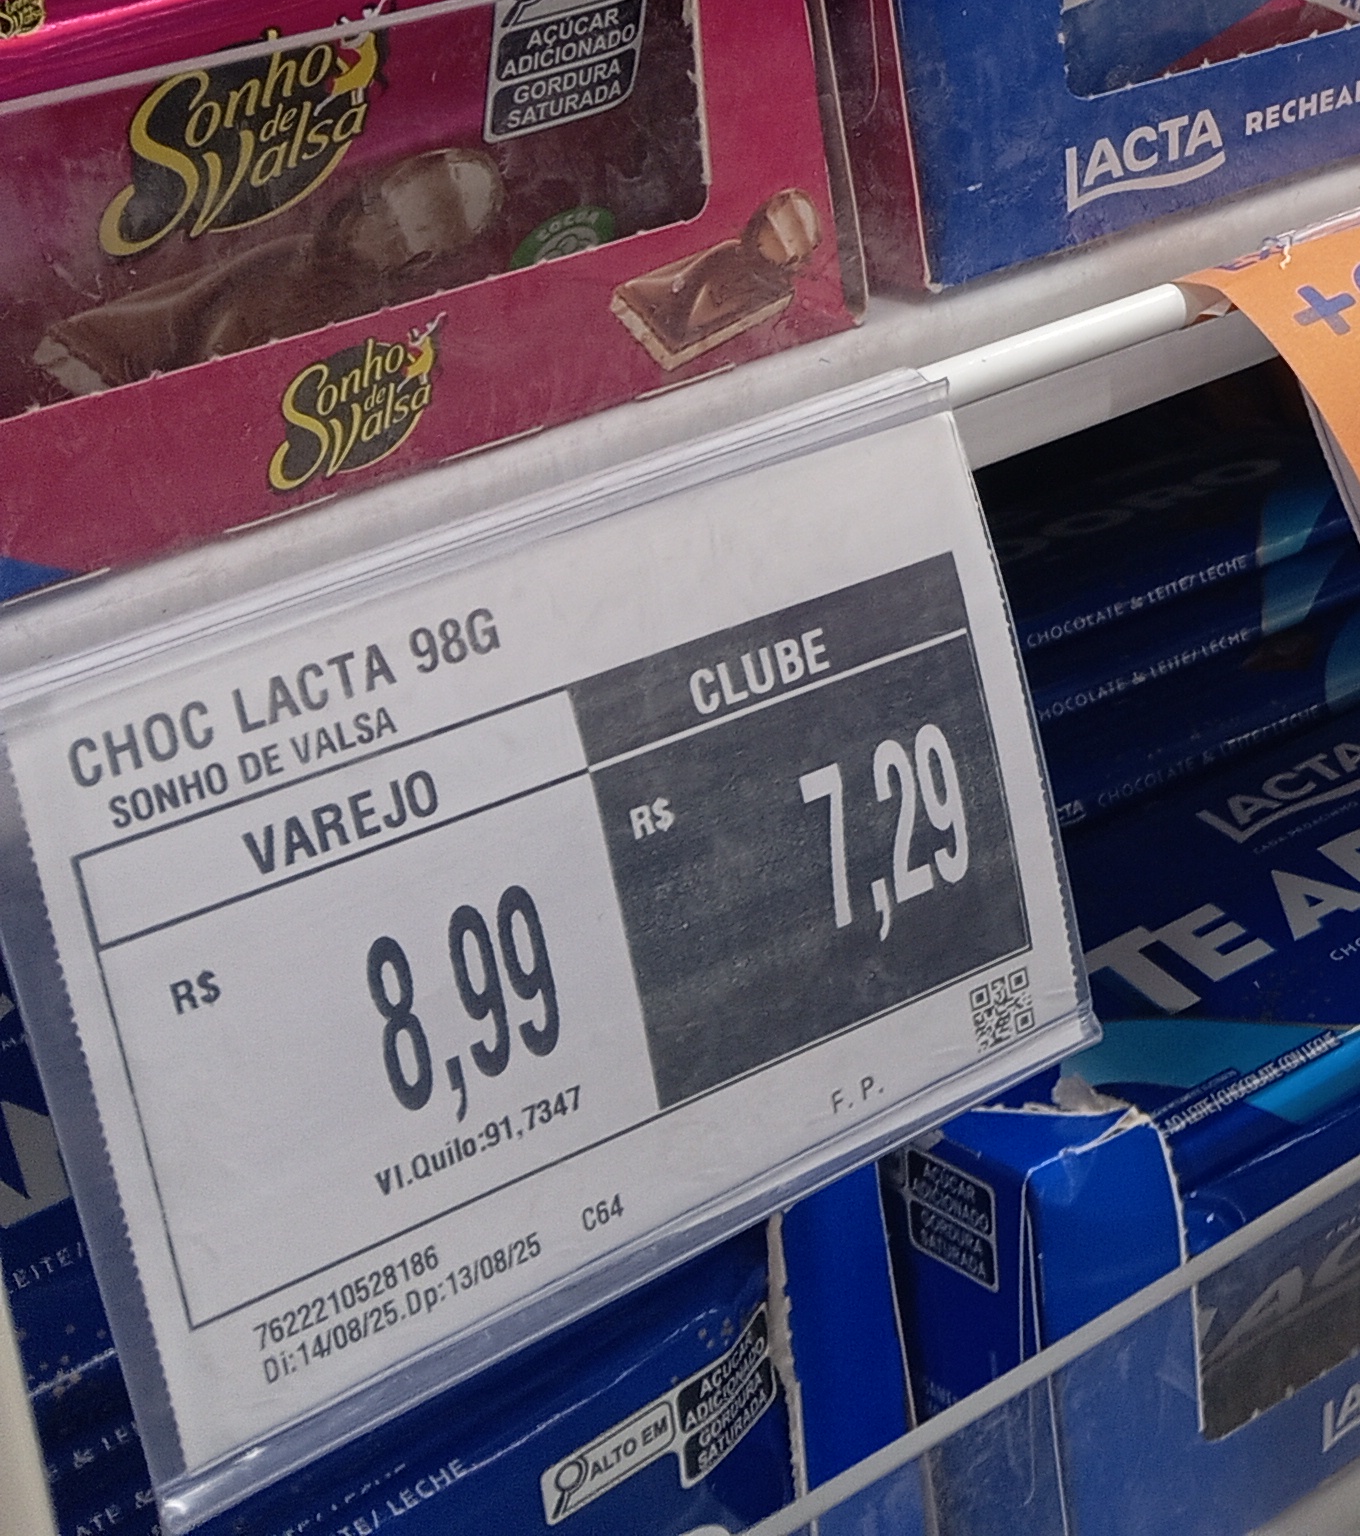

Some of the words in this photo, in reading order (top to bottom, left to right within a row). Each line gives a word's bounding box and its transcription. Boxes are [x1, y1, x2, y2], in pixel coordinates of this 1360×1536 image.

[501, 23, 635, 79] ADICIONADO
[526, 7, 619, 49] AÇÚCAR
[506, 80, 621, 129] SATURADA
[513, 59, 621, 104] GORDURA
[1065, 109, 1226, 214] LACTA
[1026, 601, 1125, 650] CHOCOLATE
[68, 696, 215, 789] CHOC
[231, 643, 398, 738] LACTA
[407, 605, 502, 677] 98G
[689, 628, 830, 716] CLUBE
[109, 768, 231, 830] SONHO
[235, 744, 284, 786] DE
[289, 704, 398, 767] VALSA
[241, 769, 441, 876] VAREJO
[629, 796, 675, 839] R$
[798, 721, 970, 944] 7,29
[169, 968, 222, 1017] R$
[364, 882, 562, 1123] 8,99
[581, 1195, 626, 1235] C64
[253, 1244, 441, 1352] 7622210528186
[260, 1232, 544, 1386] Di:14/08/25.Dp:13/08/25
[589, 1439, 639, 1482] ALTO
[641, 1414, 669, 1448] EM
[392, 1457, 466, 1516] LECHE
